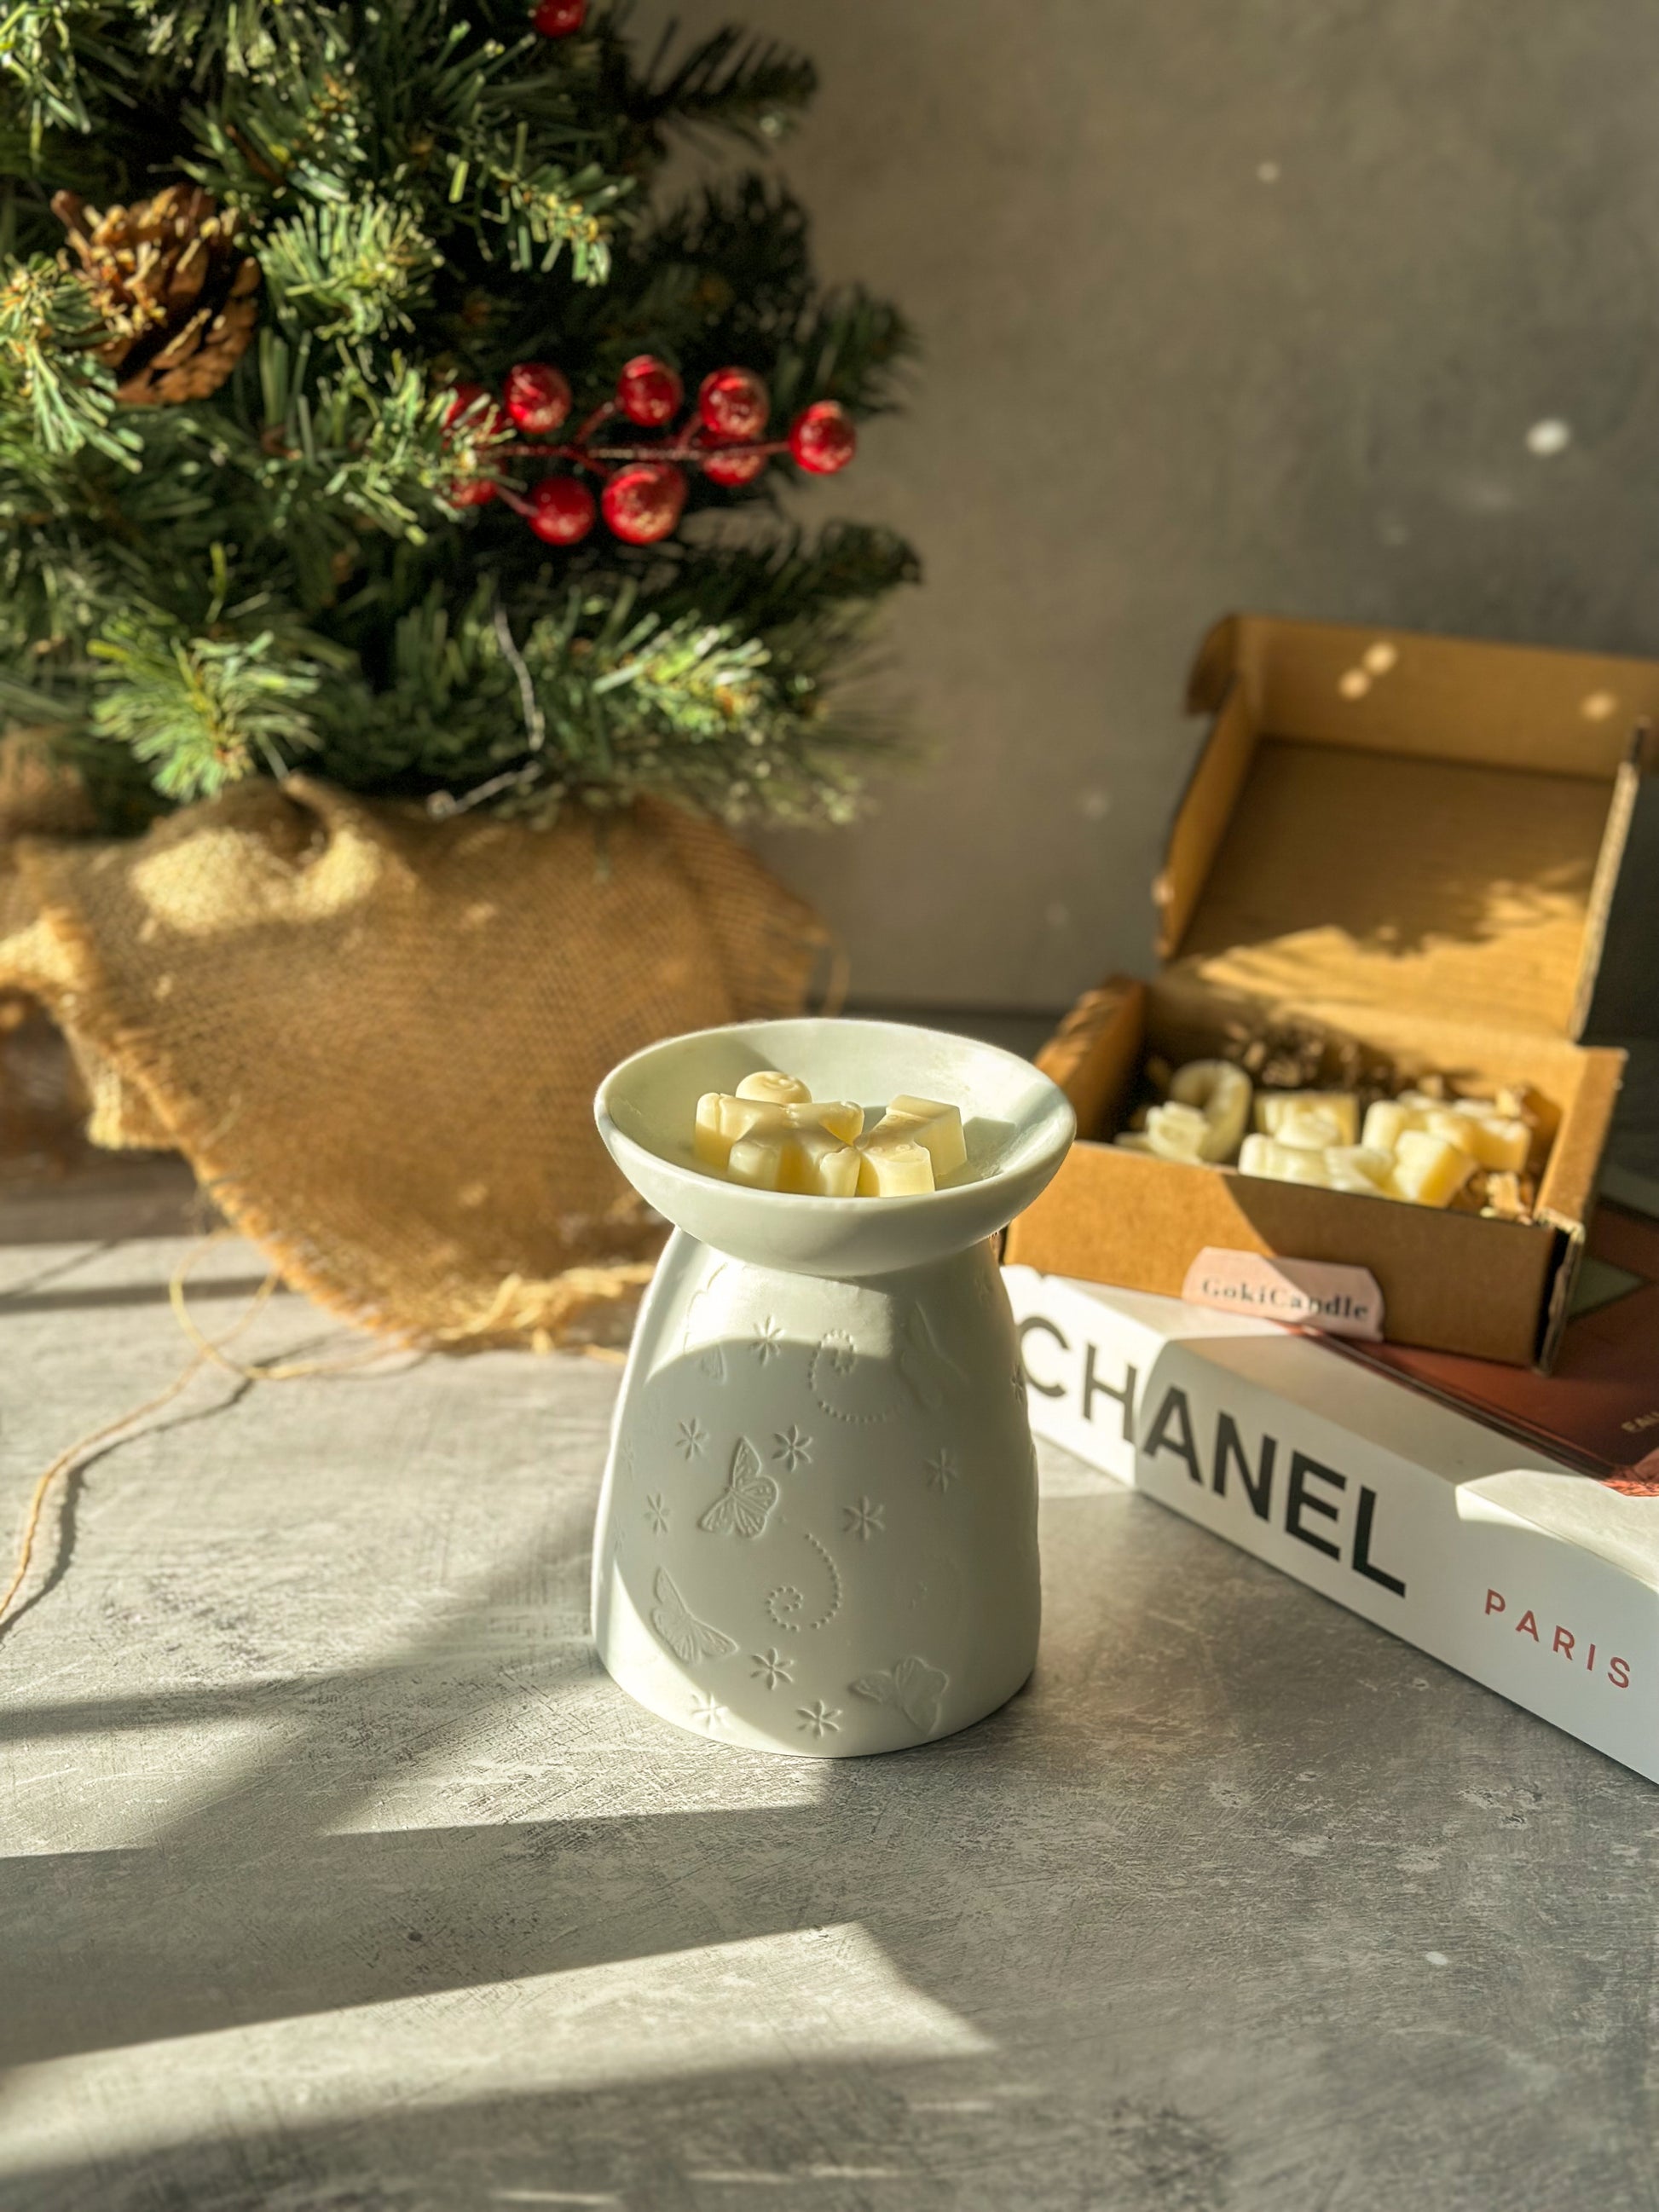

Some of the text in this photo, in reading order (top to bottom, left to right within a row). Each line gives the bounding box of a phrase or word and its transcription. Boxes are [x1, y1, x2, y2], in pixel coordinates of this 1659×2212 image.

[1202, 1279, 1368, 1319] GokiCandle
[1017, 1316, 1407, 1599] CHANEL
[1484, 1588, 1631, 1689] PARIS
